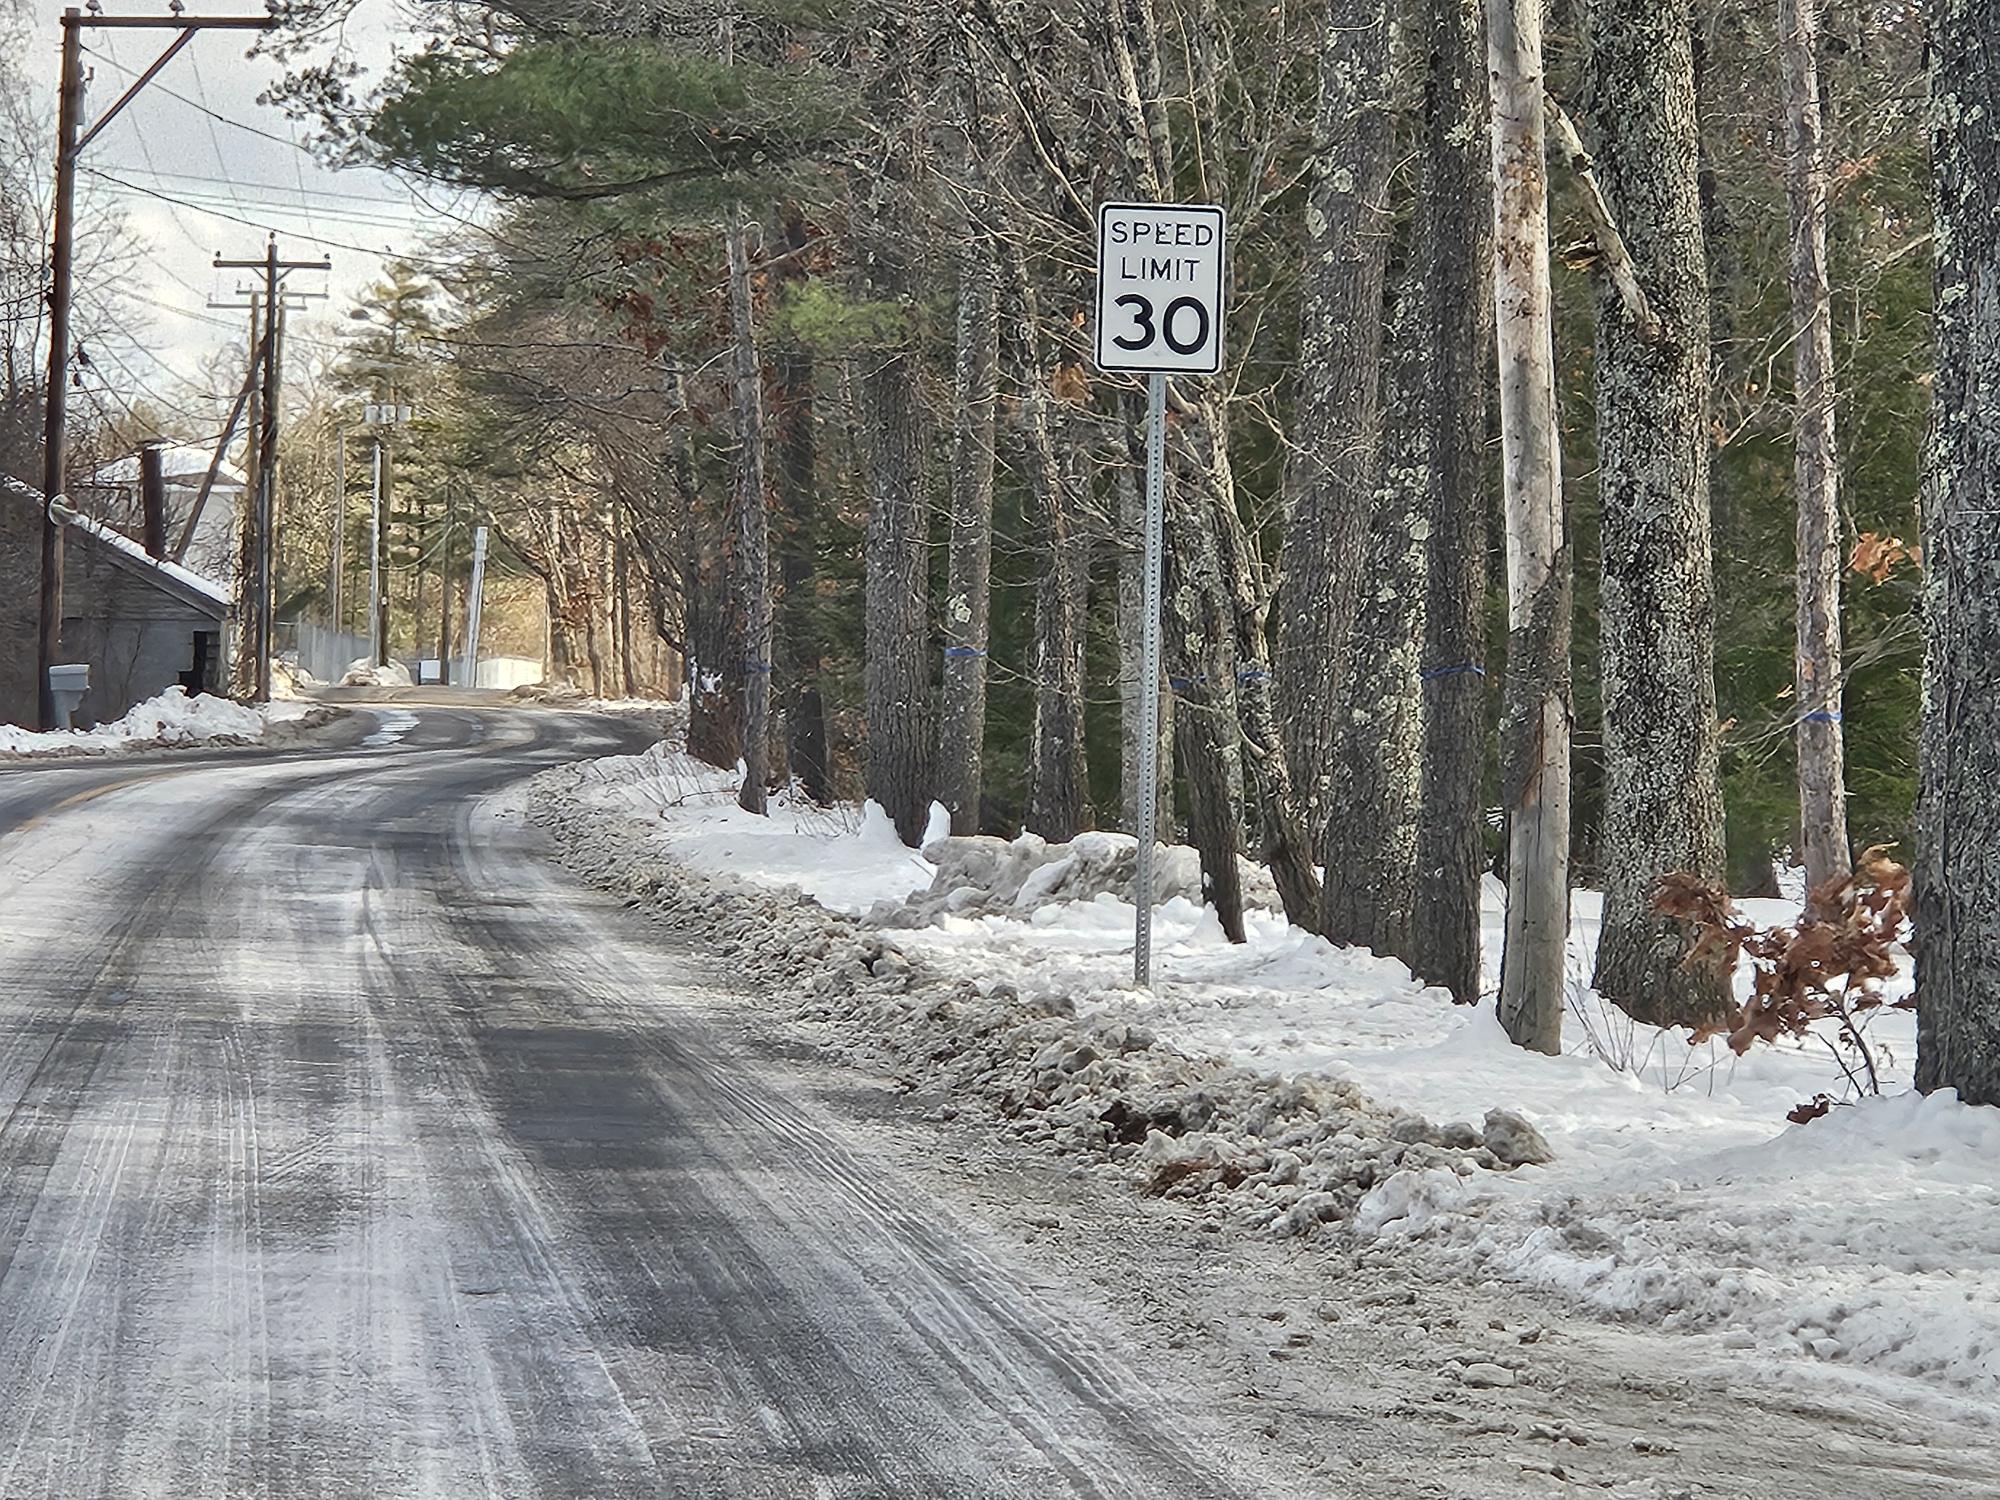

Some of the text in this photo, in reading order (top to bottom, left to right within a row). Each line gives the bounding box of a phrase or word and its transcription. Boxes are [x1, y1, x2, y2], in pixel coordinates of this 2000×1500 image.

[1111, 221, 1213, 246] SPEED
[1121, 256, 1201, 282] LIMIT
[1111, 293, 1210, 356] 30
